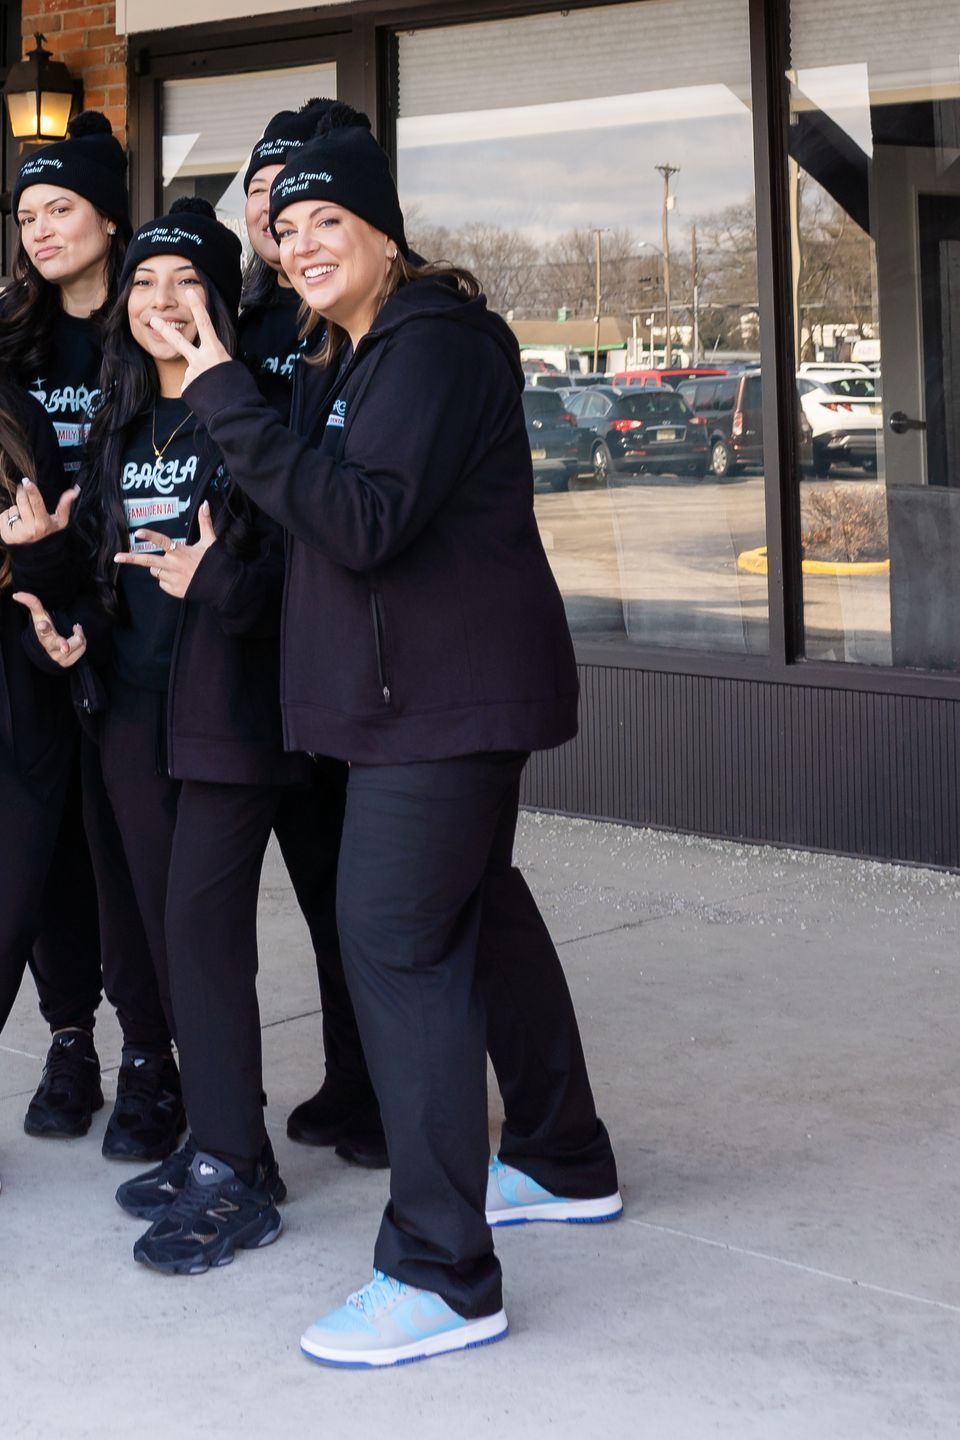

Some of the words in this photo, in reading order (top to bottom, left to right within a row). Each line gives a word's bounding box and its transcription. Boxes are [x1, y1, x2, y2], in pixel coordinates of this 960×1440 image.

[298, 171, 333, 183] Family
[282, 180, 310, 197] Dental
[151, 234, 181, 243] Dental
[171, 227, 203, 245] Family
[122, 456, 198, 495] BARCLA
